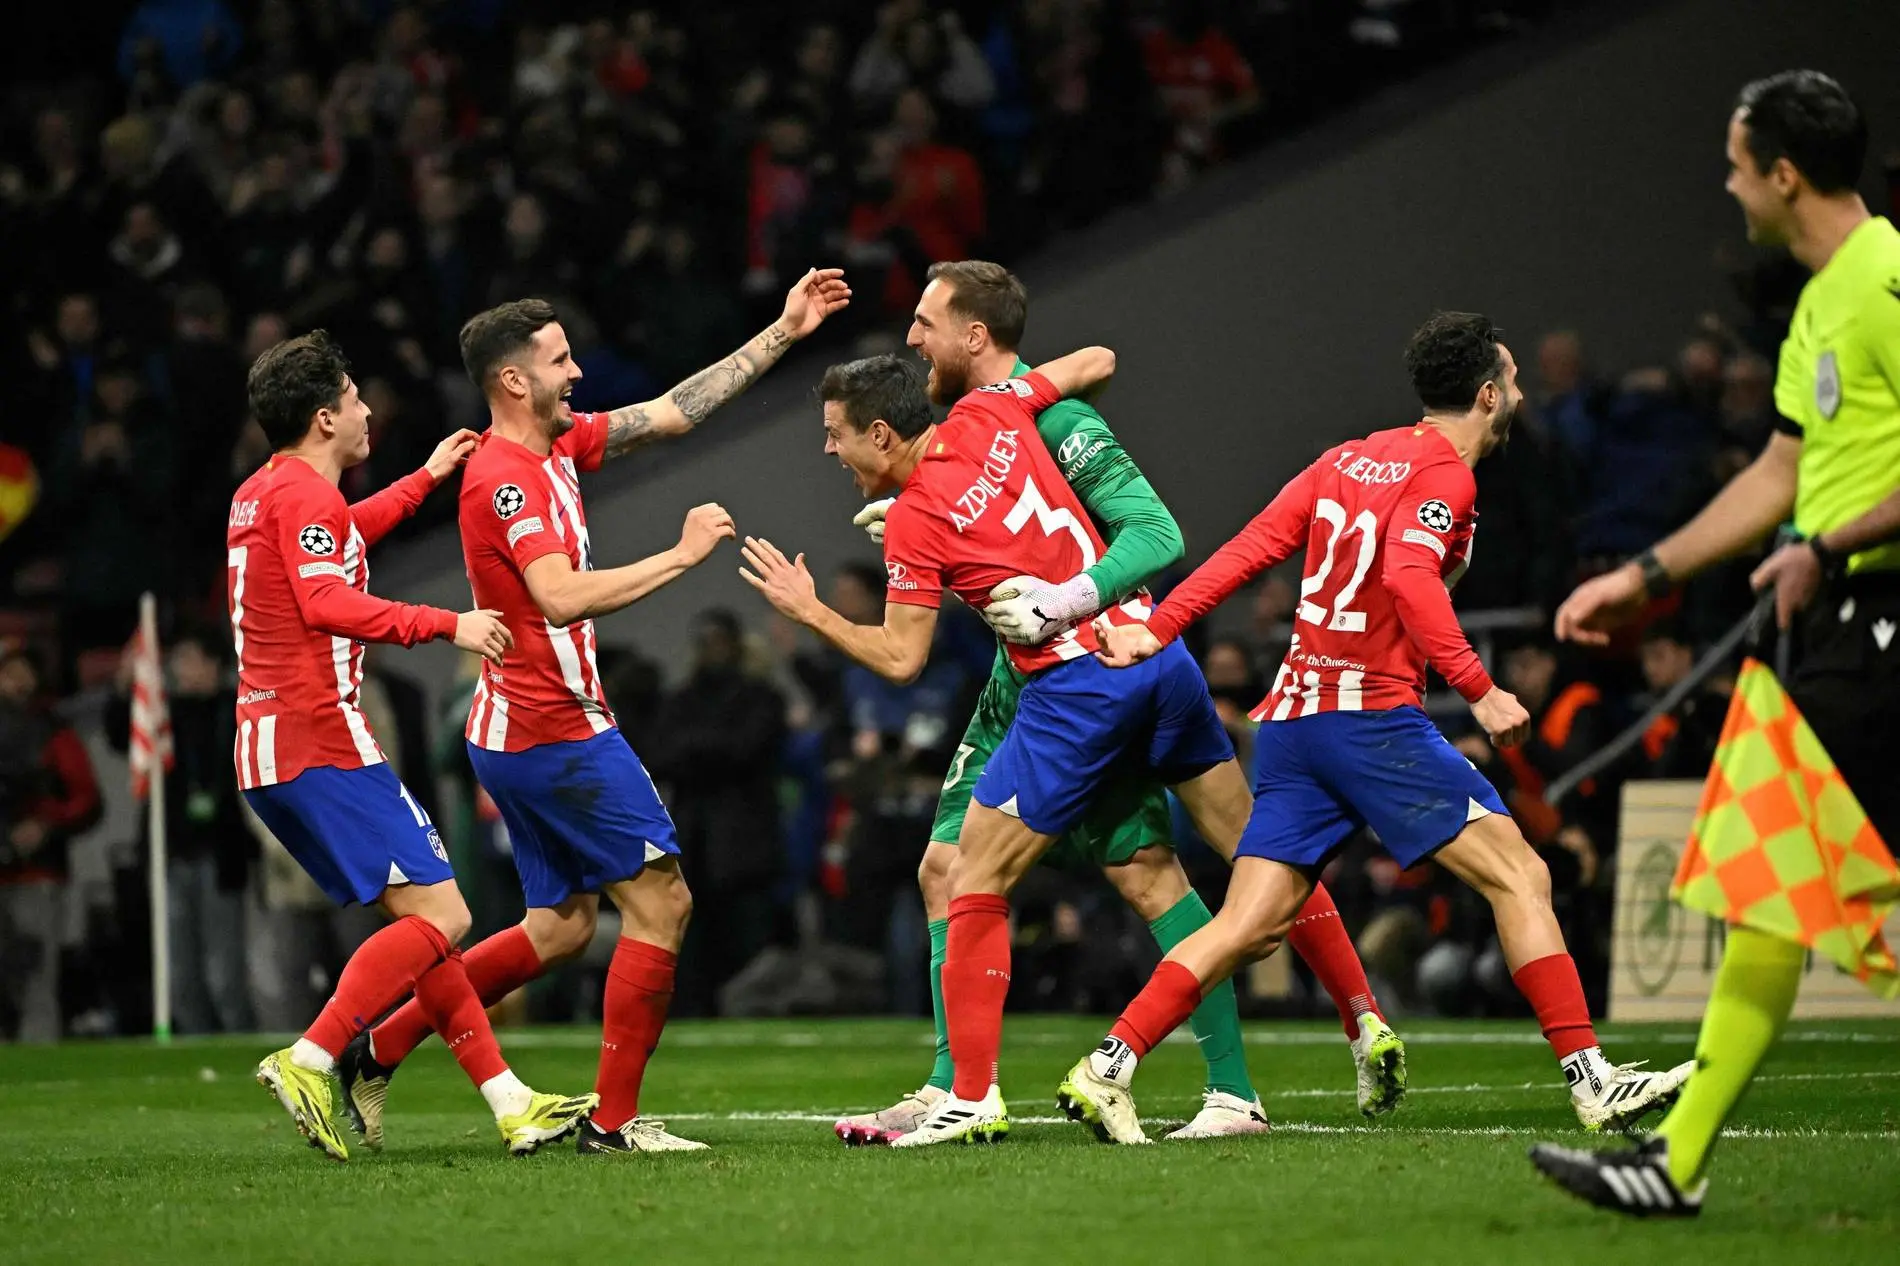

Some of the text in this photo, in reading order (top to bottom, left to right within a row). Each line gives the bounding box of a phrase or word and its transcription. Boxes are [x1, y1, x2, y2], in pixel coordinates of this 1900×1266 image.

[1002, 473, 1096, 572] 3
[1296, 498, 1377, 632] 22
[228, 545, 247, 672] 7
